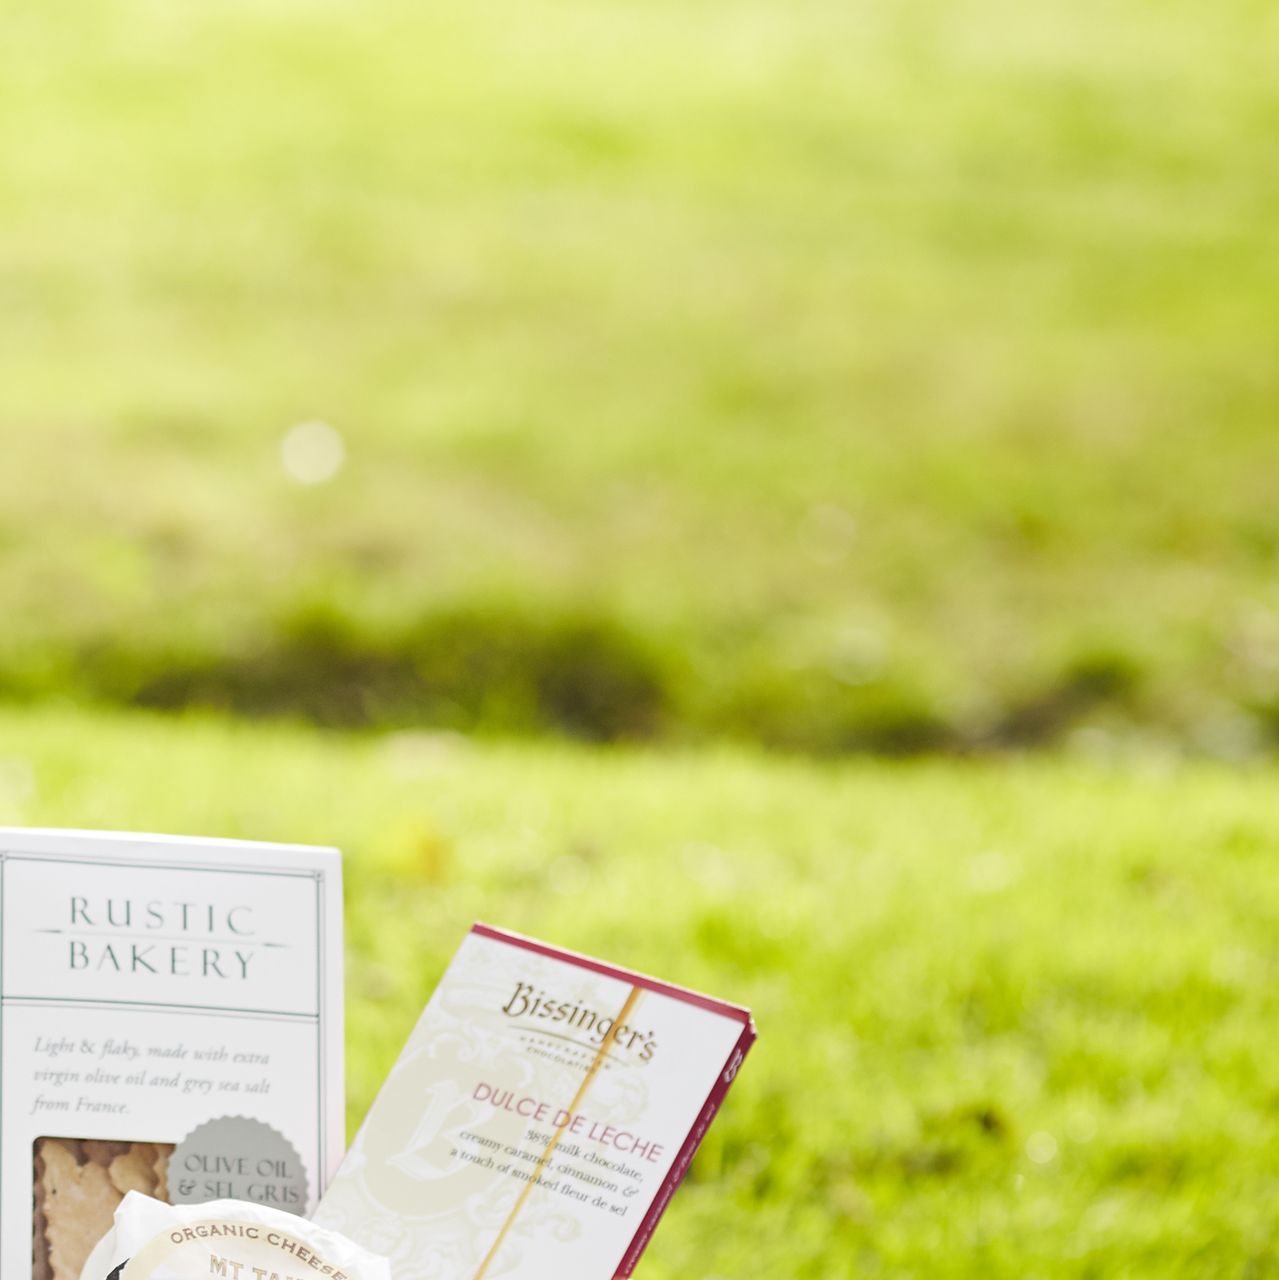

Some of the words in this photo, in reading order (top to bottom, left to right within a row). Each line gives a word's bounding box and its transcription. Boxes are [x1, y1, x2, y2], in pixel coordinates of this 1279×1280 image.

[70, 896, 256, 936] RUSTIC
[69, 941, 255, 980] BAKERY
[502, 982, 658, 1063] Bissinger's
[33, 1037, 76, 1058] Light
[79, 1040, 96, 1054] &
[147, 1043, 188, 1060] made
[193, 1045, 229, 1063] with
[232, 1052, 271, 1066] extra
[33, 1068, 80, 1087] virgin
[84, 1068, 121, 1084] olive
[125, 1071, 145, 1087] oil
[149, 1073, 180, 1088] and
[182, 1079, 213, 1094] grey
[218, 1079, 240, 1091] sea
[245, 1078, 271, 1094] salt
[30, 1095, 70, 1114] from
[75, 1097, 131, 1114] France.
[472, 1082, 551, 1122] DULCE
[551, 1109, 587, 1134] DE
[588, 1122, 665, 1163] LECHE
[183, 1154, 250, 1176] OLIVE
[256, 1159, 294, 1180] OIL
[459, 1130, 504, 1153] creamy
[557, 1163, 619, 1193] cinnamon
[621, 1186, 640, 1198] &
[554, 1140, 581, 1159] milk
[583, 1152, 644, 1183] chocolate,
[178, 1179, 196, 1196] &
[247, 1183, 301, 1204] GRIS
[449, 1147, 459, 1157] a
[459, 1150, 495, 1170] touch
[496, 1161, 511, 1173] of
[511, 1167, 561, 1193] smoked
[560, 1184, 590, 1203] fleur
[591, 1194, 609, 1208] de
[609, 1204, 629, 1218] sel
[170, 1224, 260, 1245] ORGANIC
[209, 1254, 244, 1280] MT
